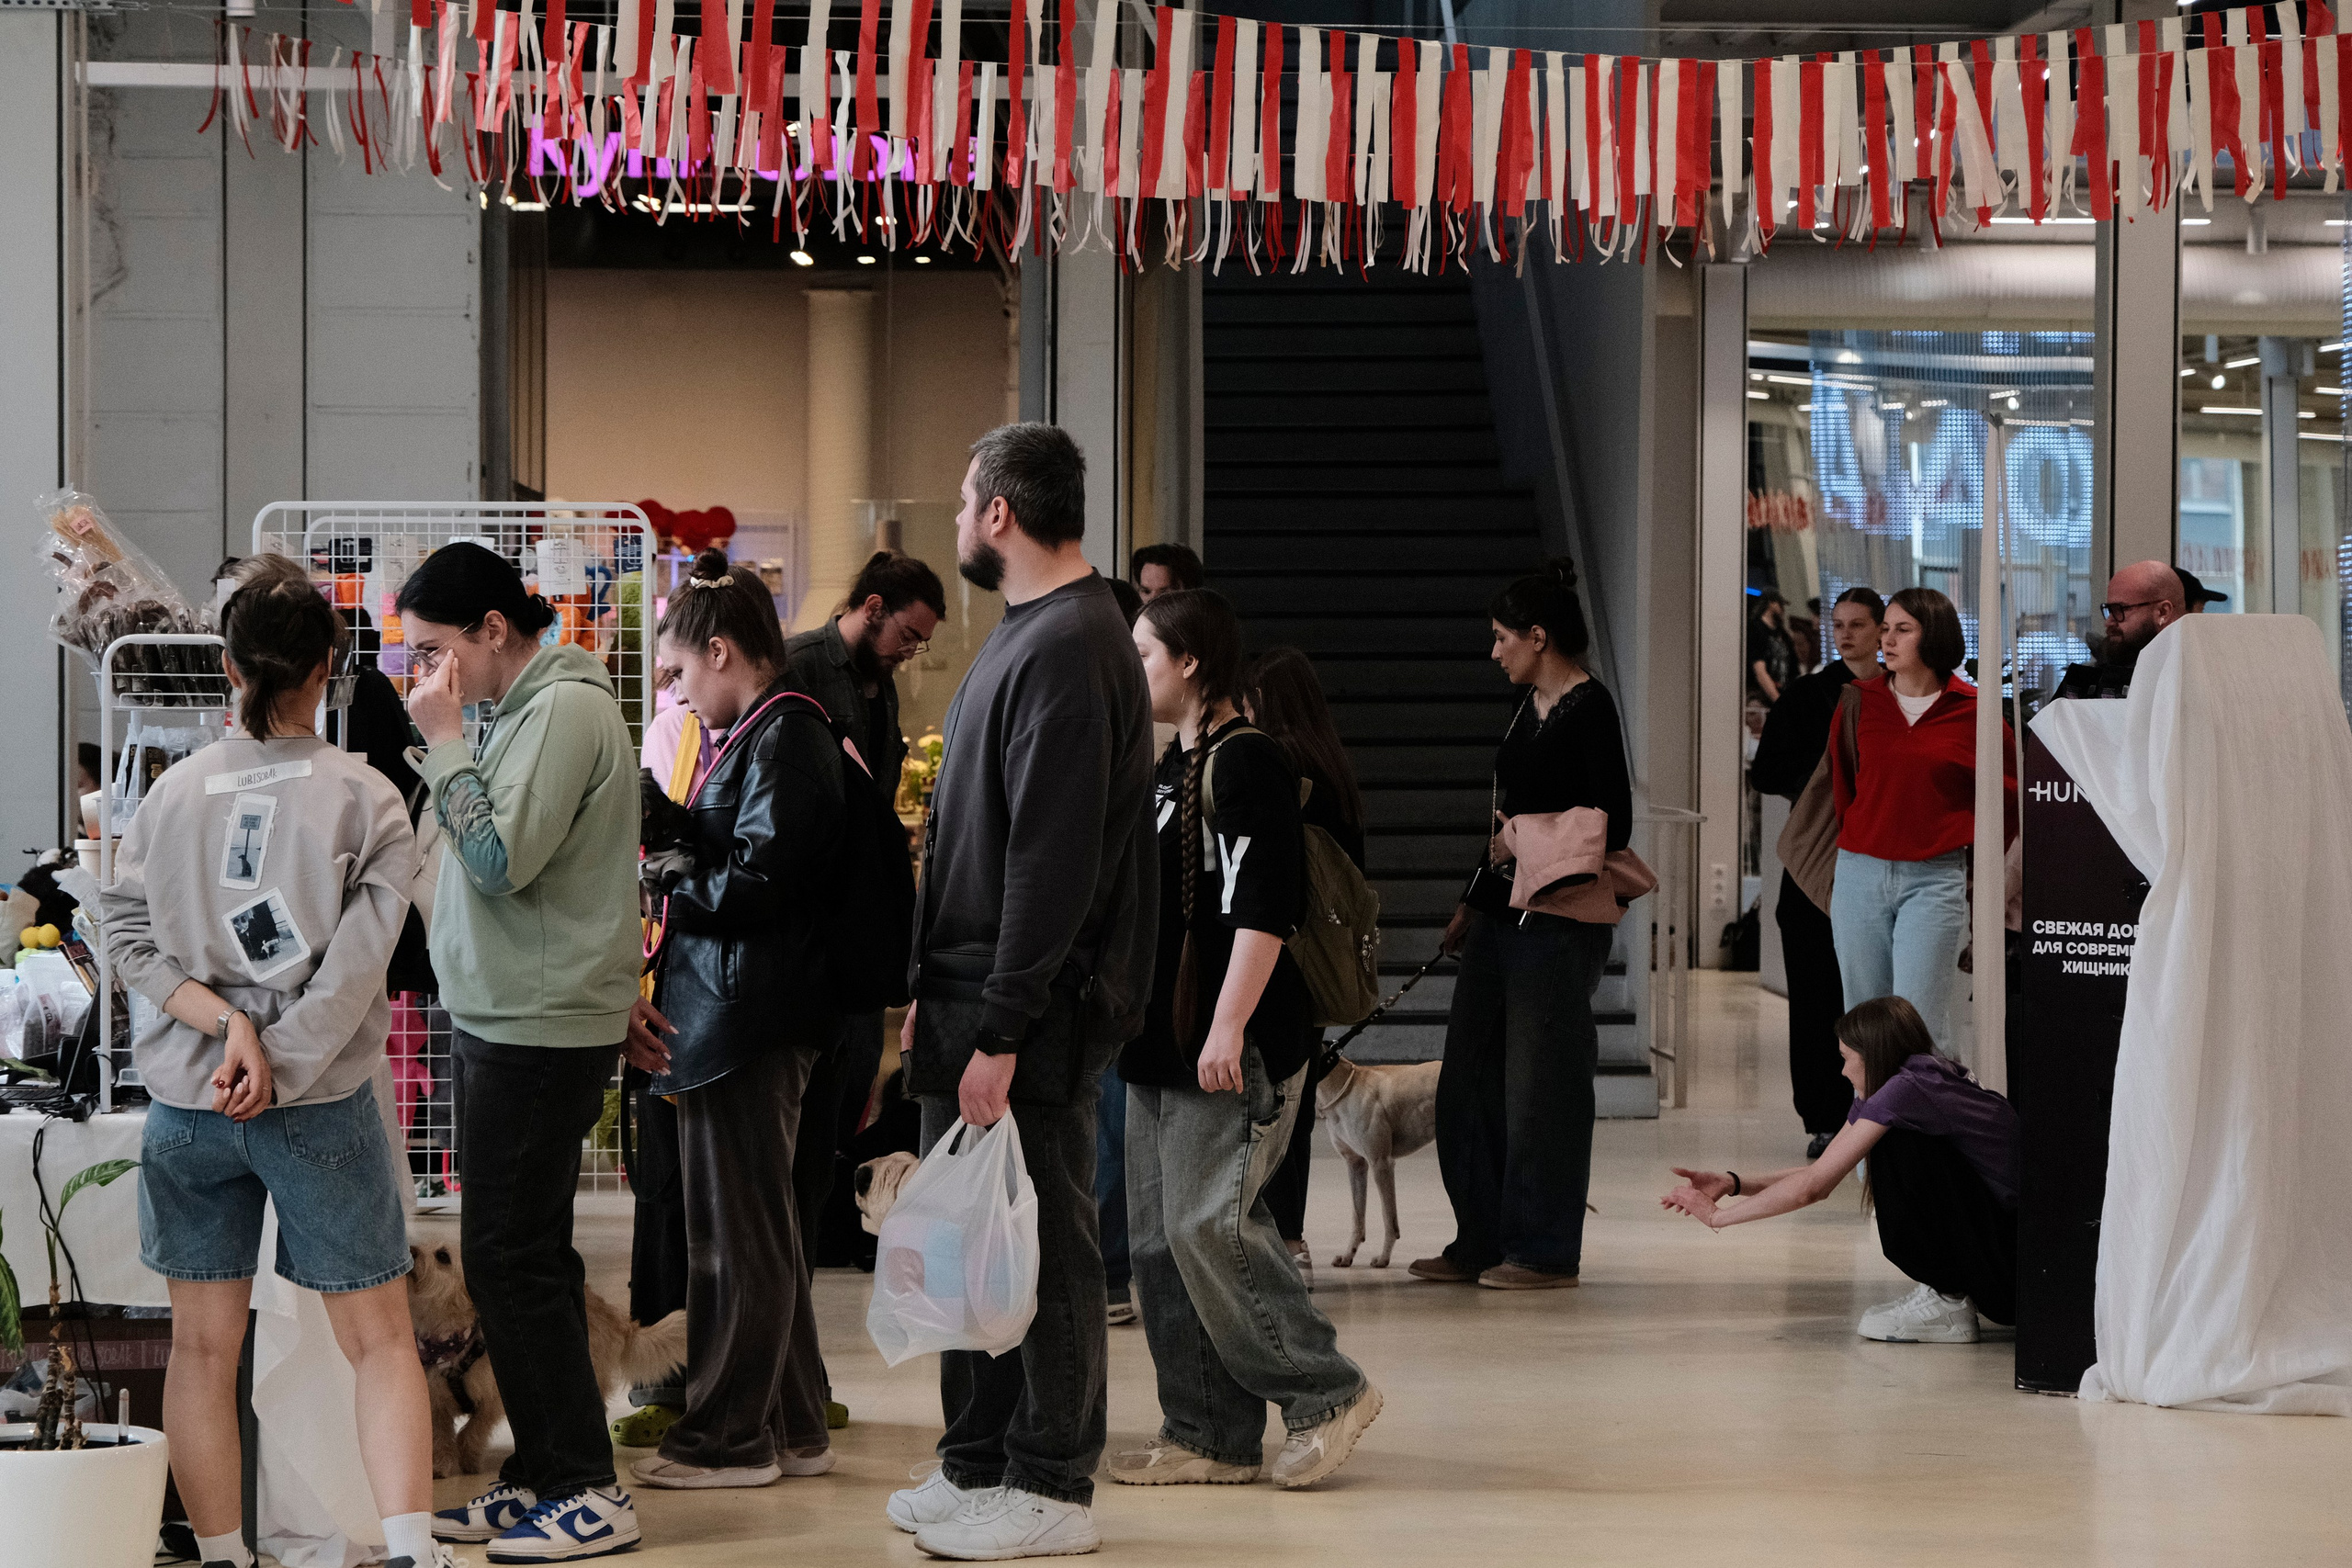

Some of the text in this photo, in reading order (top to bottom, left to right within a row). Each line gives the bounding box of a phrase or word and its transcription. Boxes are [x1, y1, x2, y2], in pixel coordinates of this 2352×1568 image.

[2032, 919, 2104, 937] СВЕЖАЯ
[2032, 940, 2063, 954] ДЛЯ
[2062, 960, 2131, 976] ХИЩНИК
